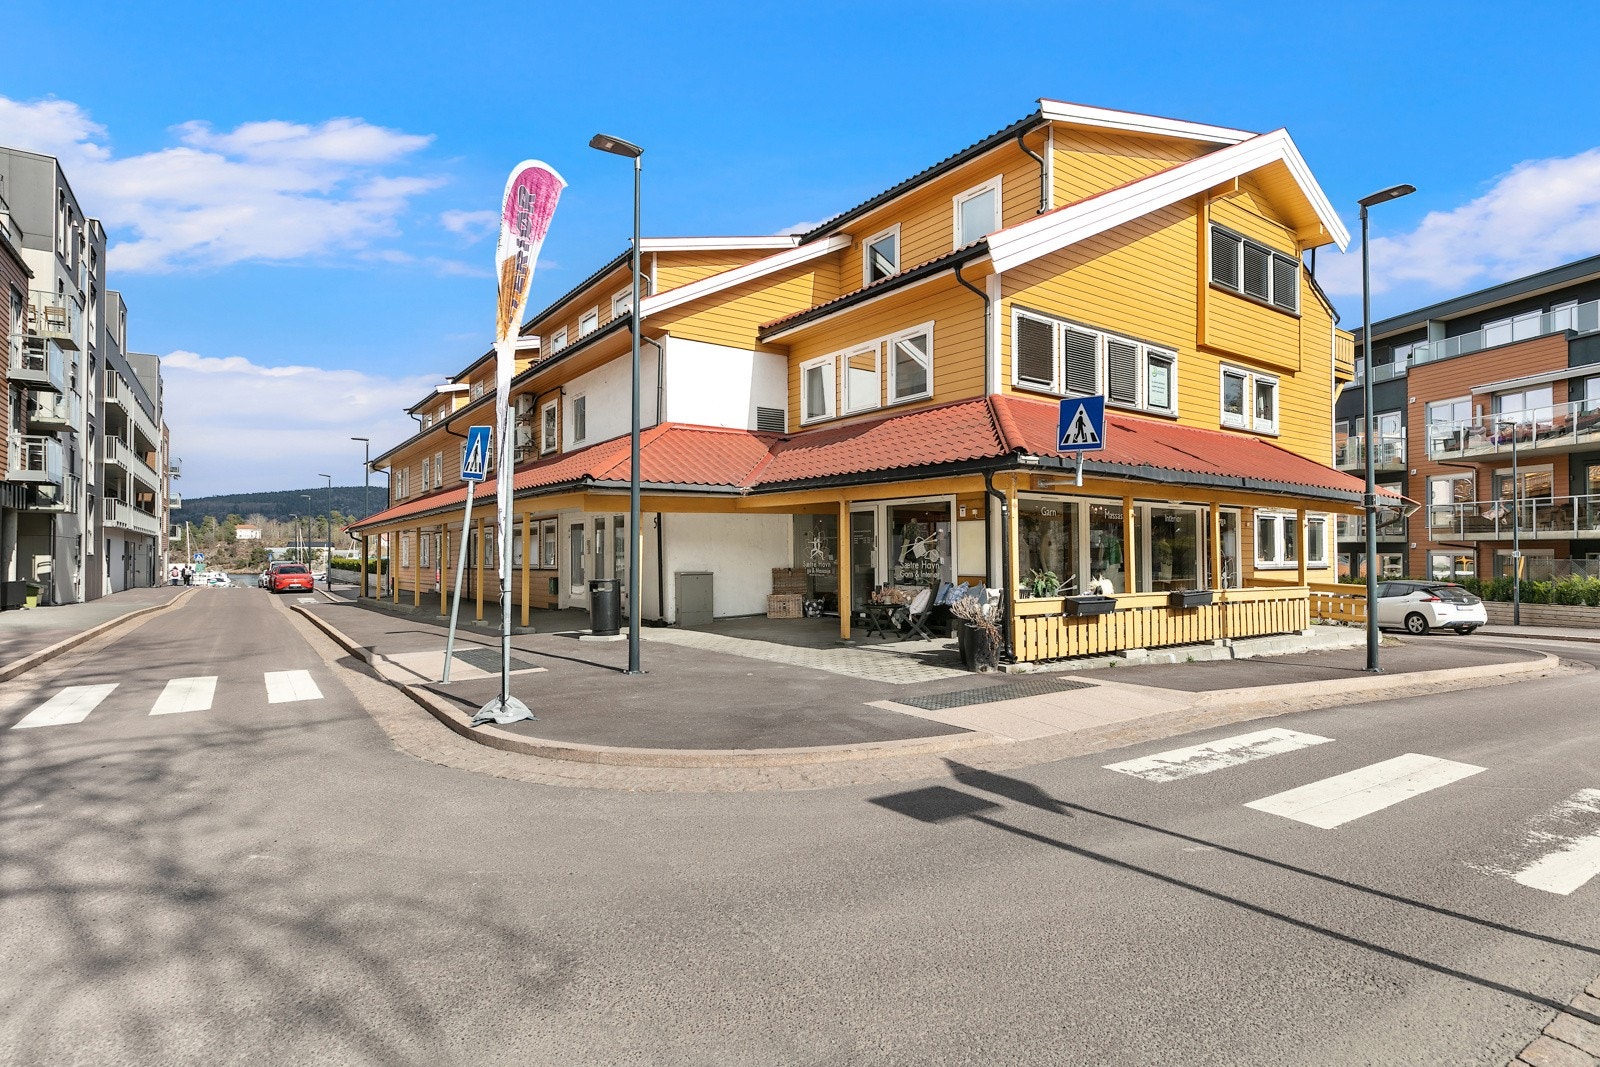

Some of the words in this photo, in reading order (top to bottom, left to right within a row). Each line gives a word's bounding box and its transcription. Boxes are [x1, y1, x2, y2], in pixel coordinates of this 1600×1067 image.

[1041, 506, 1057, 516] Garn
[1104, 510, 1123, 520] Massas
[921, 560, 940, 570] Havn
[899, 570, 914, 578] Garn
[914, 570, 920, 578] &
